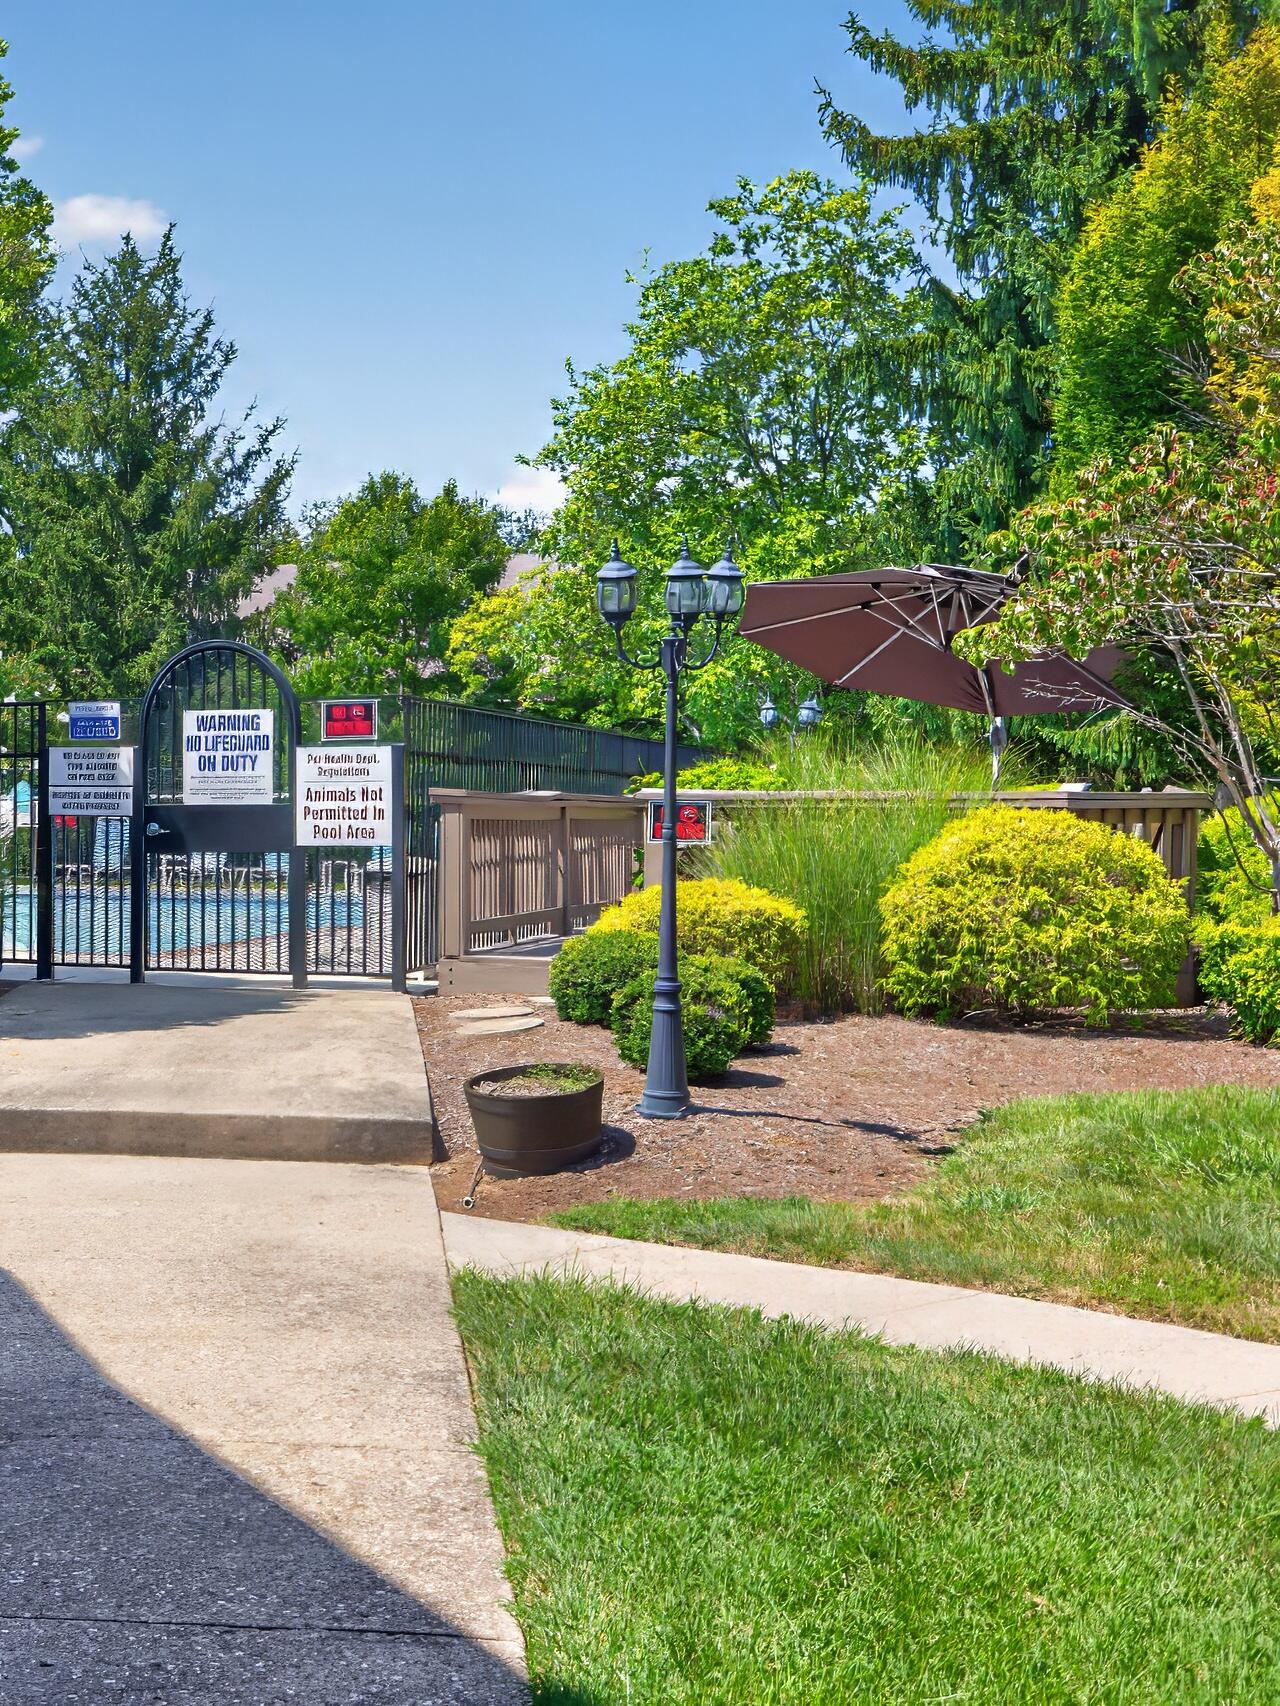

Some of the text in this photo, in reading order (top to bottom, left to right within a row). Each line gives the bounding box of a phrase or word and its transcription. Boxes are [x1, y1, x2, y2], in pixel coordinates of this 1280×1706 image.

[196, 714, 261, 732] WARNING
[186, 734, 270, 752] NO LIFEGUARD
[198, 754, 258, 772] ON DUTY
[324, 753, 353, 764] Health
[306, 786, 383, 802] Animals Not
[303, 804, 385, 821] Permitted In
[313, 824, 375, 839] Pool Area
